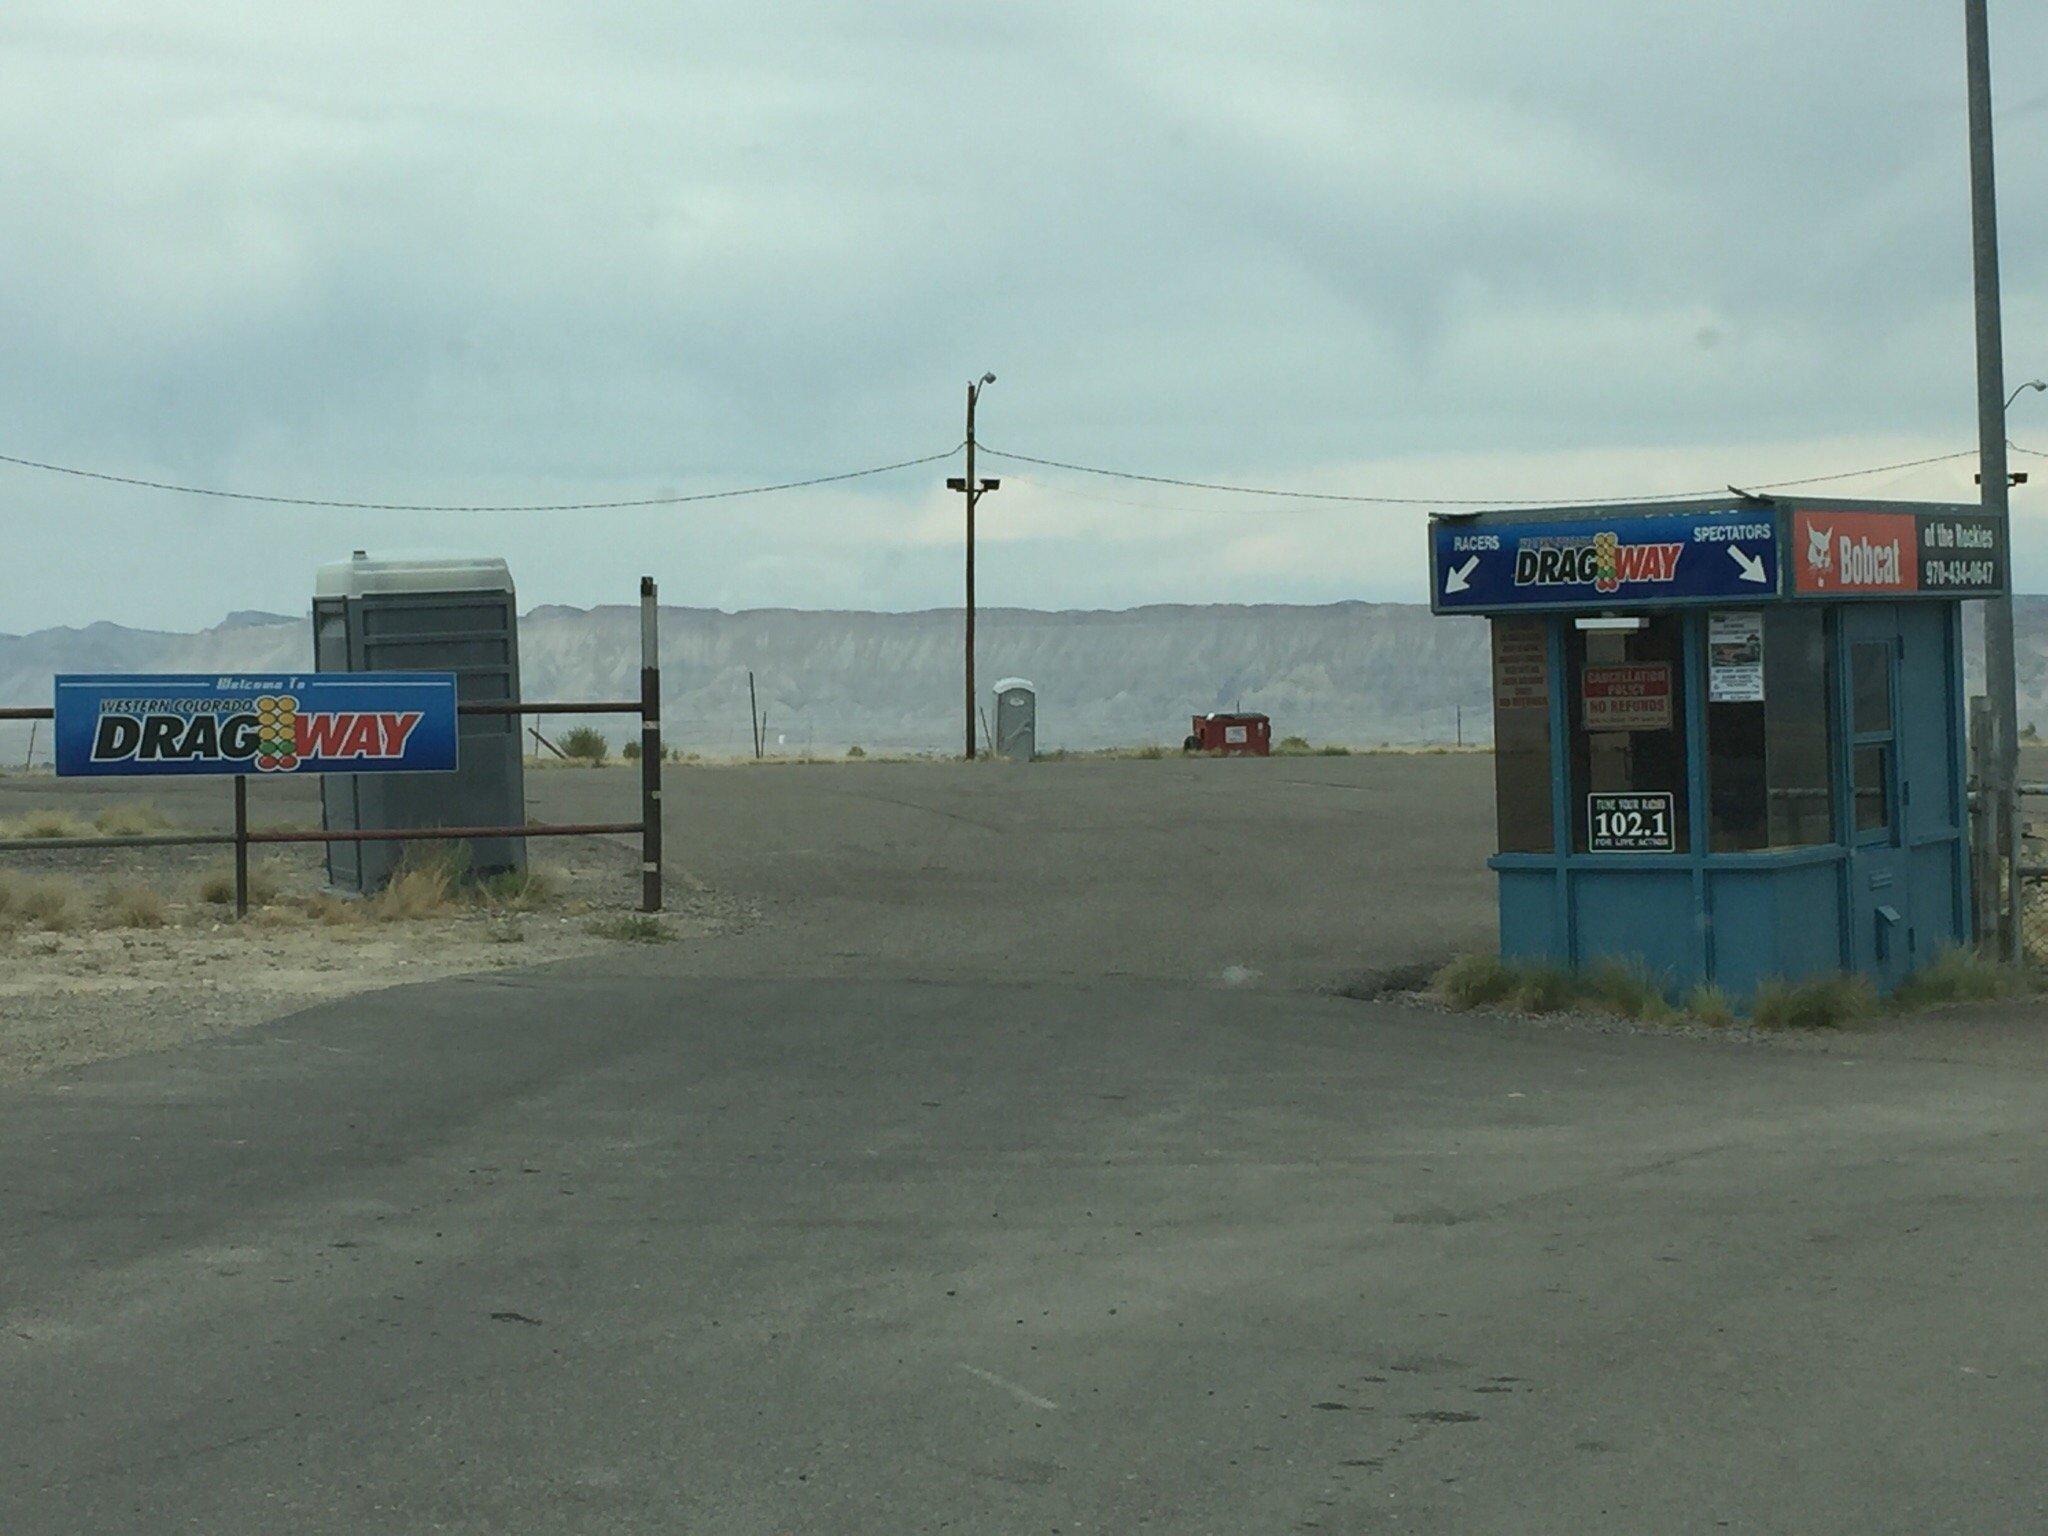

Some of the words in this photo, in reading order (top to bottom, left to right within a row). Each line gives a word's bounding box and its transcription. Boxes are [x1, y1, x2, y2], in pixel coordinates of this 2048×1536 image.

[1454, 535, 1500, 551] RACERS
[1693, 523, 1772, 542] SPECTATORS
[1924, 522, 1935, 547] of
[1937, 523, 1954, 548] the
[1955, 523, 1993, 549] Rockies
[1515, 548, 1600, 586] DRAG
[1613, 543, 1685, 582] WAY
[1839, 535, 1901, 585] Bobcat
[216, 677, 283, 690] Welcome
[289, 676, 306, 690] To
[101, 699, 170, 713] WESTERN
[173, 699, 254, 713] COLORADO
[1589, 700, 1607, 713] NO
[1610, 699, 1665, 712] REFUNDS
[90, 713, 262, 762] DRAG
[294, 711, 426, 760] WAY
[1595, 811, 1668, 837] 102.1
